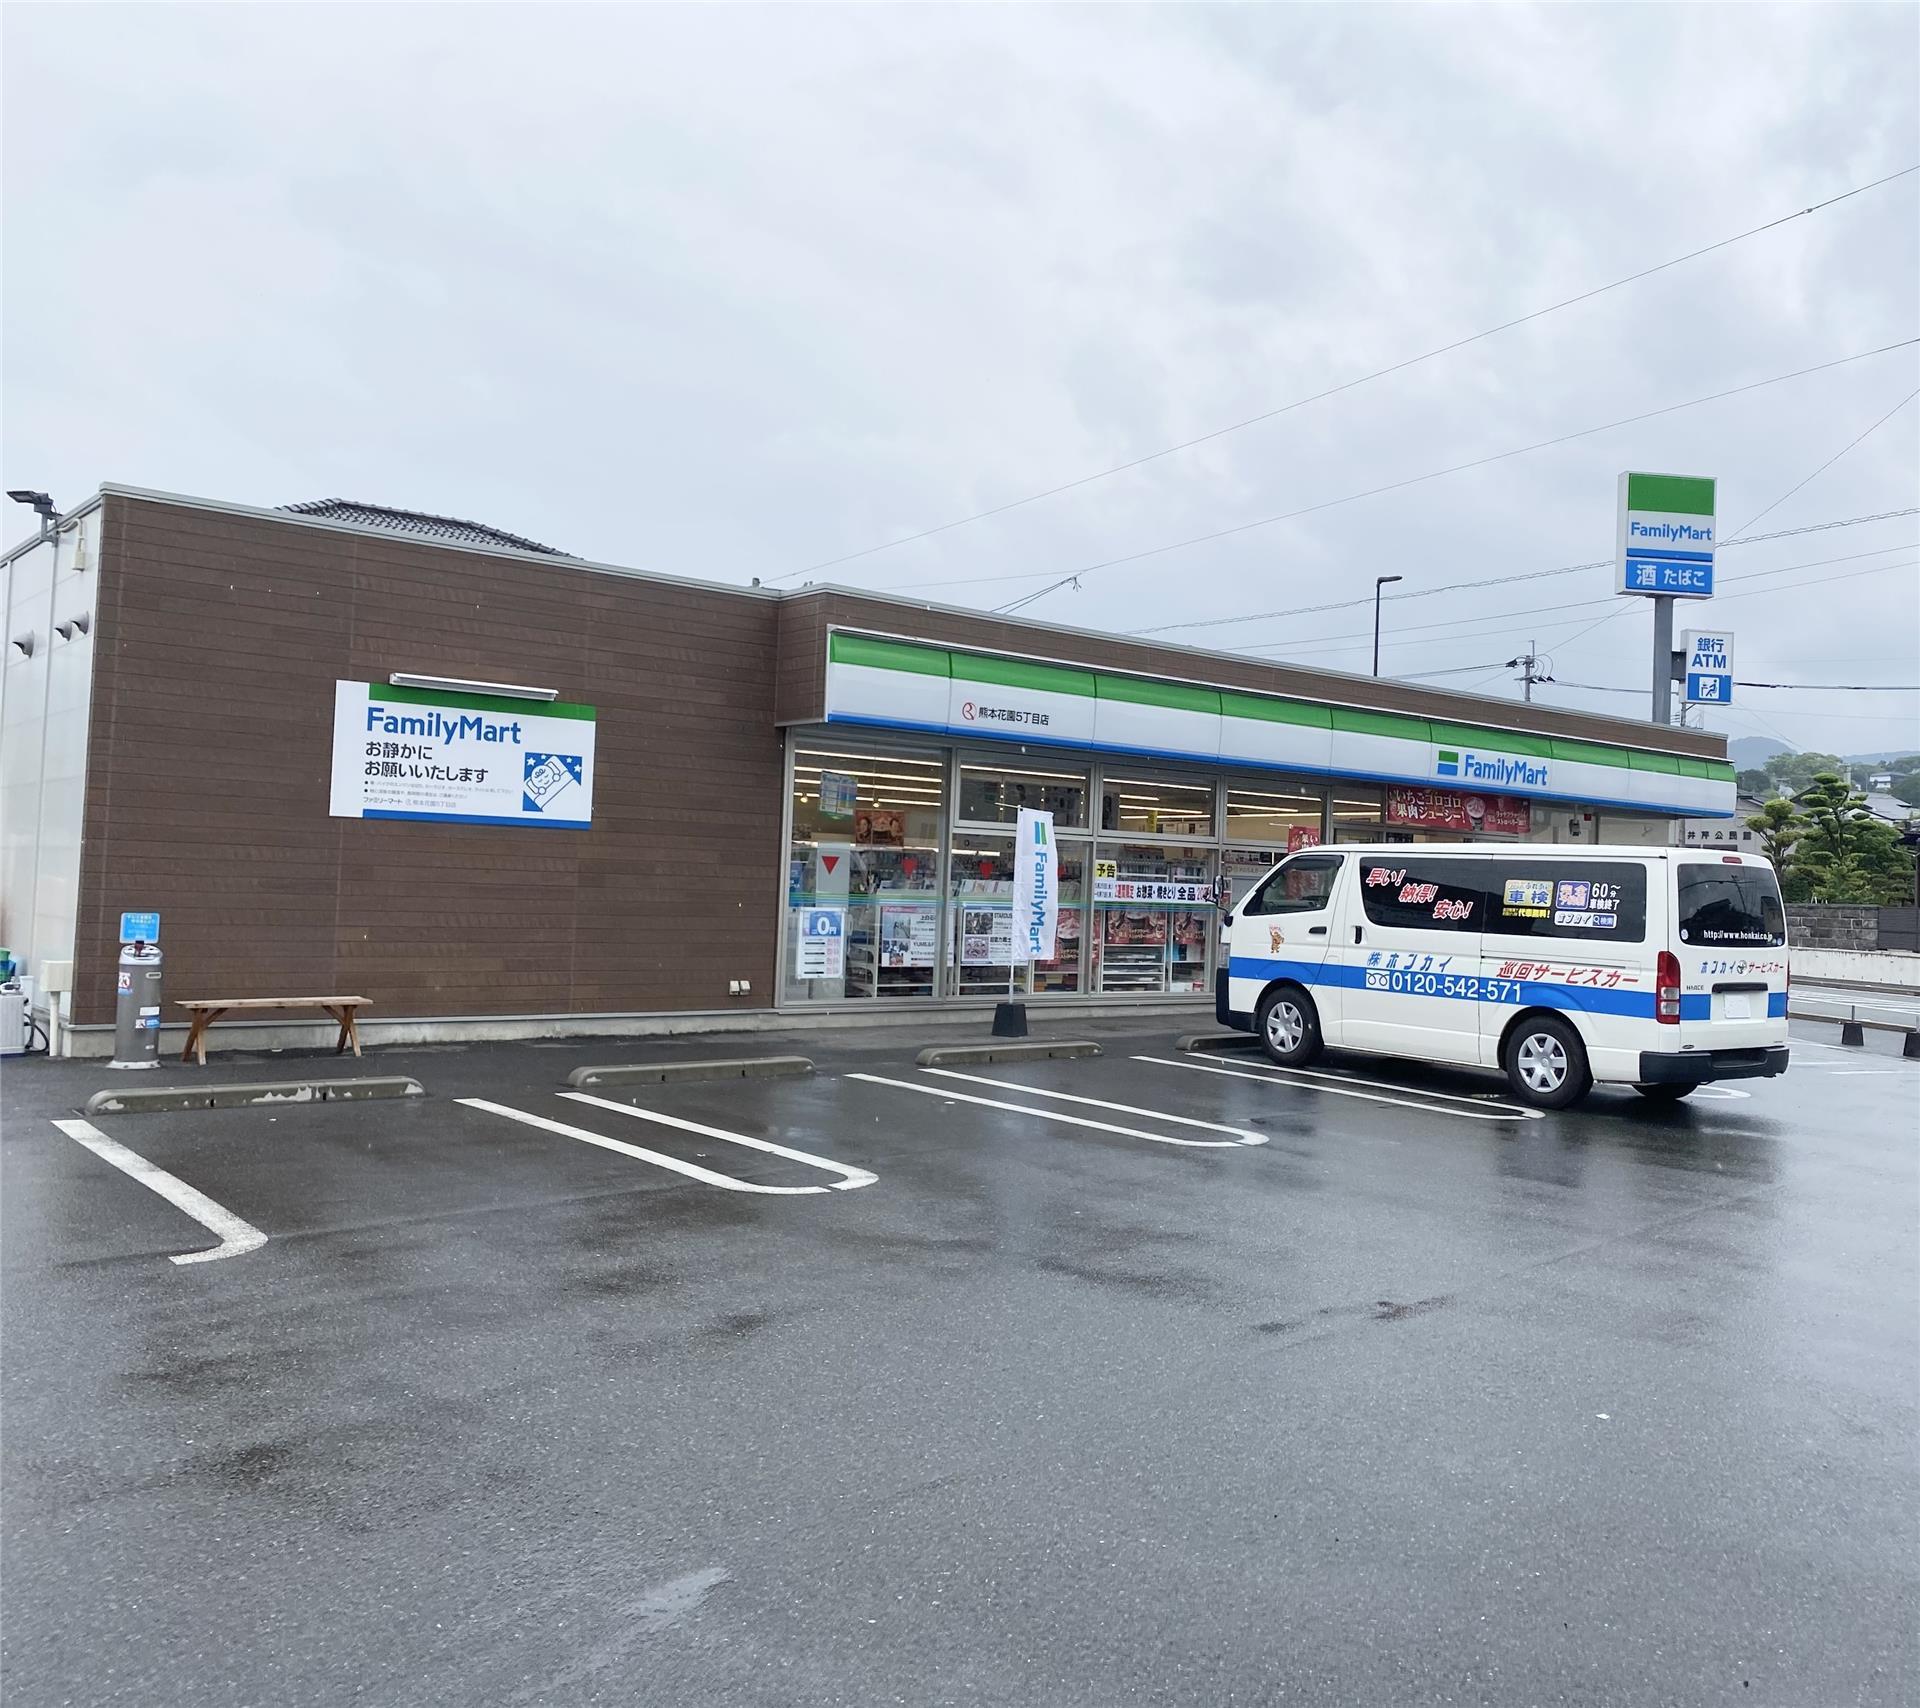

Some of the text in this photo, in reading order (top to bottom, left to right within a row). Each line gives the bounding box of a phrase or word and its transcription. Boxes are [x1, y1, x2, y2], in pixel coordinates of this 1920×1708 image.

[1630, 521, 1712, 542] FamilyMart
[1636, 564, 1705, 586] 酒 たばこ
[1697, 637, 1724, 653] 銀行
[1691, 653, 1727, 669] ATM
[367, 706, 521, 745] FamilyMart
[978, 706, 1049, 726] 熊本花園5丁目店
[365, 741, 433, 760] お静かに
[364, 760, 489, 784] お願いいたします
[1464, 754, 1548, 786] FamilyMart
[1096, 863, 1115, 878] 予告
[1366, 867, 1406, 888] 早い!
[1029, 851, 1048, 953] FamilyMart
[1177, 886, 1196, 901] 全品
[1398, 884, 1438, 904] 納得!
[1507, 889, 1549, 905] 車検
[1432, 901, 1473, 920] 安心!
[1702, 929, 1774, 941] http://www.honkai.co.jp
[1496, 961, 1640, 988] 巡回サービスカー
[1748, 961, 1785, 974] サービスカー
[1391, 972, 1522, 1003] 0120-542-571
